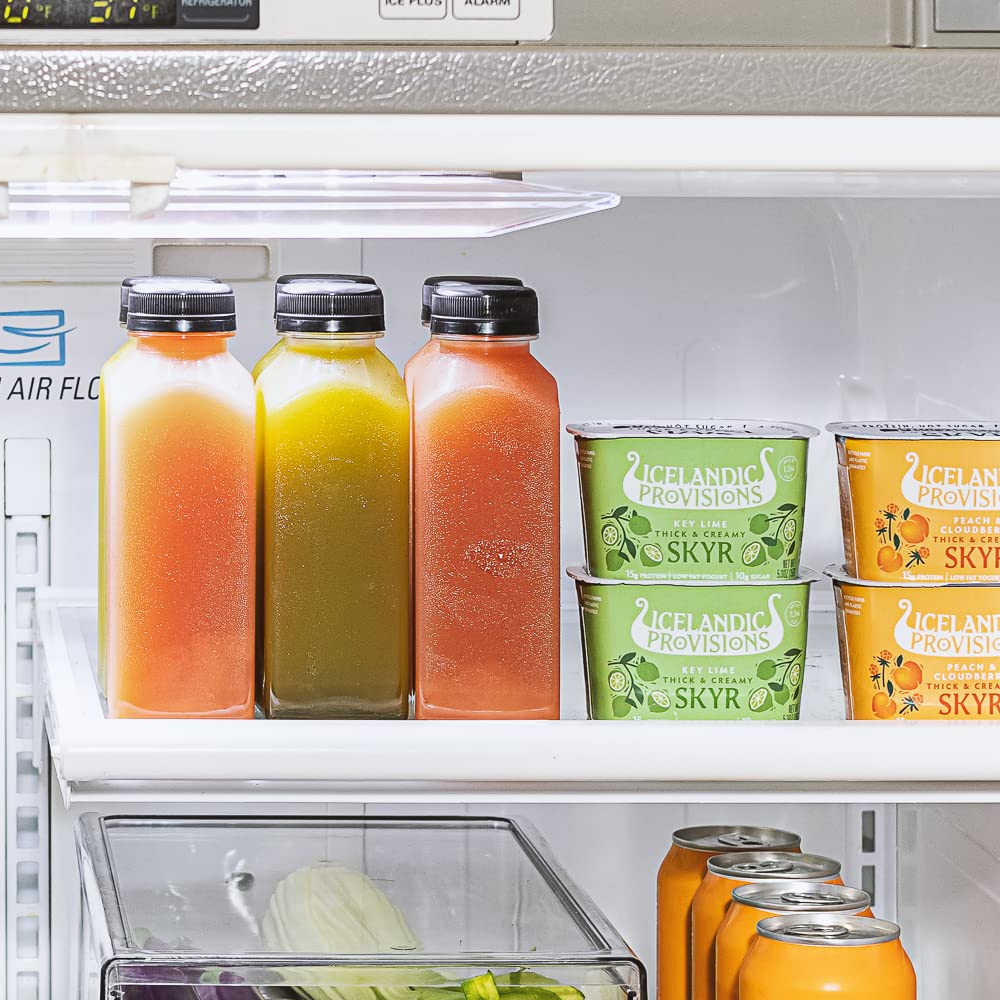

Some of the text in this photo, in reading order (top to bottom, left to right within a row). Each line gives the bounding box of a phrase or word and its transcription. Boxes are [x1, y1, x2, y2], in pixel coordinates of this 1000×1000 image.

[7, 377, 53, 400] AIR
[642, 463, 760, 486] ICELANDIC
[921, 465, 1000, 487] ICELAN
[639, 485, 763, 507] PROVISIONS
[673, 520, 728, 529] KEY LIME
[953, 516, 991, 525] PEACH
[655, 530, 688, 538] THICK
[703, 530, 747, 539] CREAMY
[933, 536, 965, 544] THICK
[969, 536, 976, 544] &
[667, 540, 735, 564] SKYR
[650, 610, 768, 633] ICELANDIC
[647, 630, 771, 654] PROVISIONS
[681, 665, 736, 675] KEY LIME
[947, 663, 996, 672] PEACH &
[662, 676, 695, 684] THICK
[711, 676, 753, 685] CREAMY
[926, 682, 958, 690] THICK
[963, 682, 970, 690] &
[675, 686, 741, 710] SKYR
